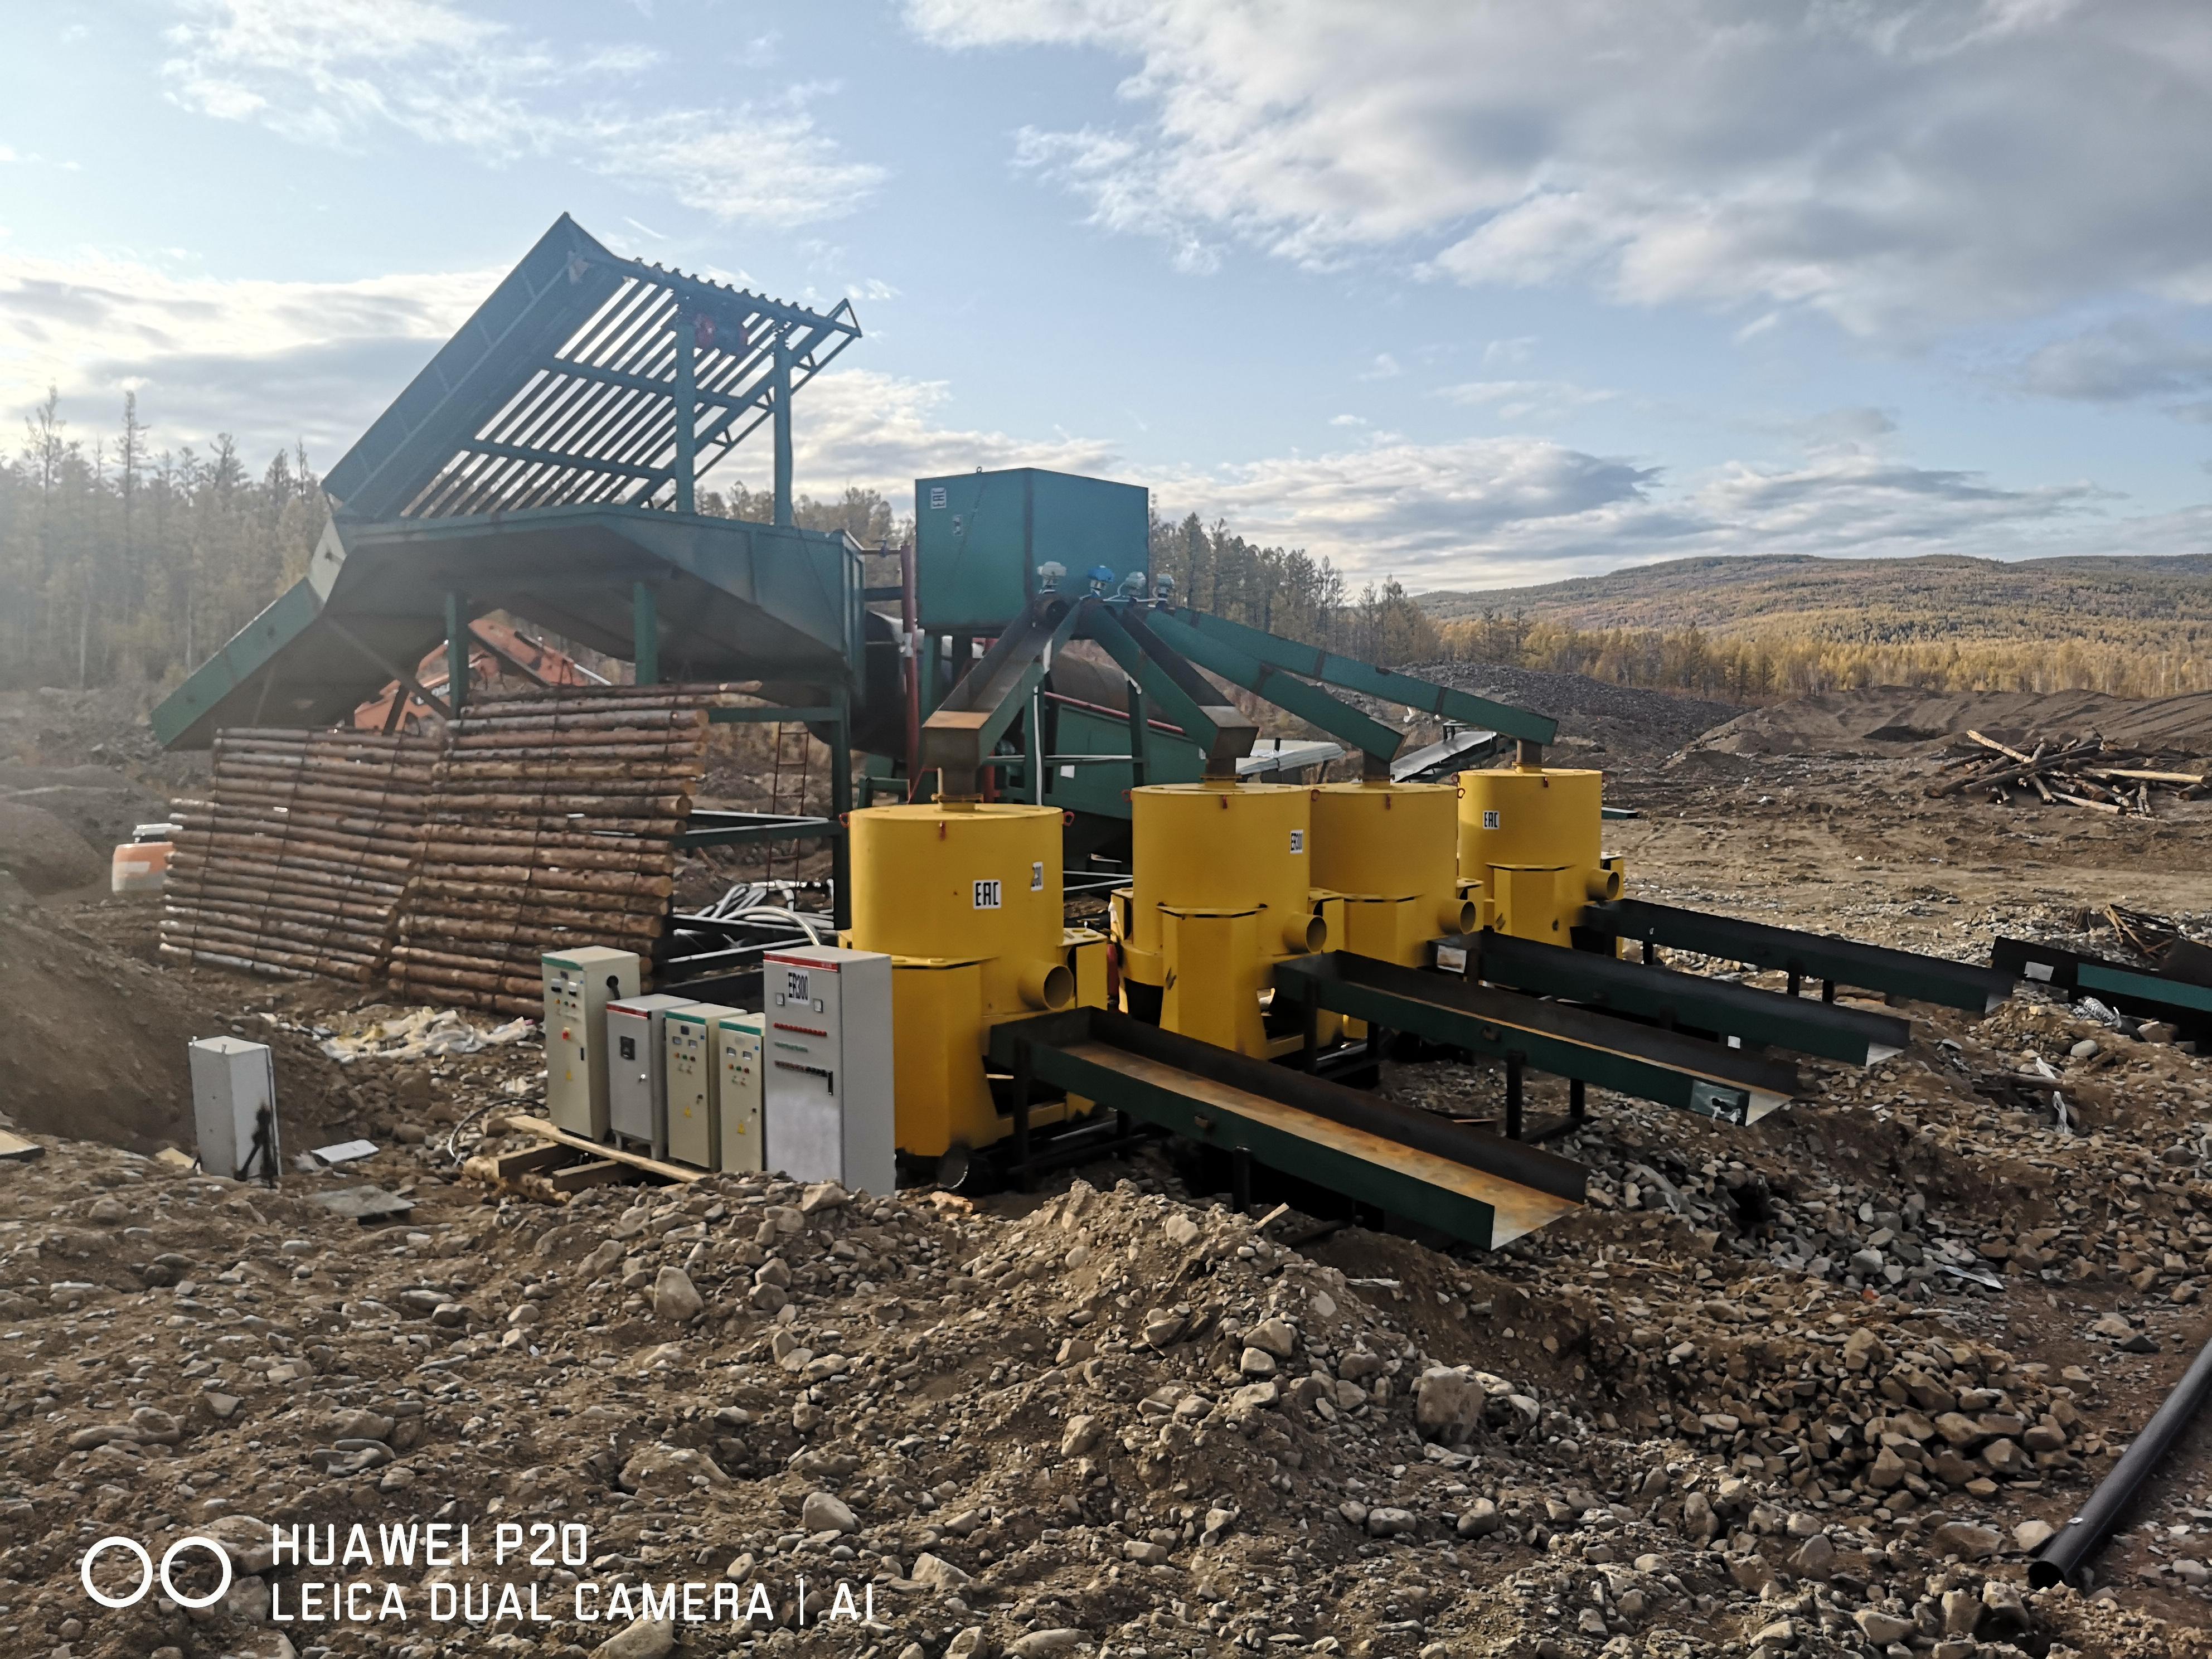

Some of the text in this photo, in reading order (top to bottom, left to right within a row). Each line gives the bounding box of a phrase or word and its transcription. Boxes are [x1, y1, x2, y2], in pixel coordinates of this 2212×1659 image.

[1484, 812, 1498, 828] EAC
[976, 882, 999, 906] EAC
[788, 972, 808, 1001] ER300
